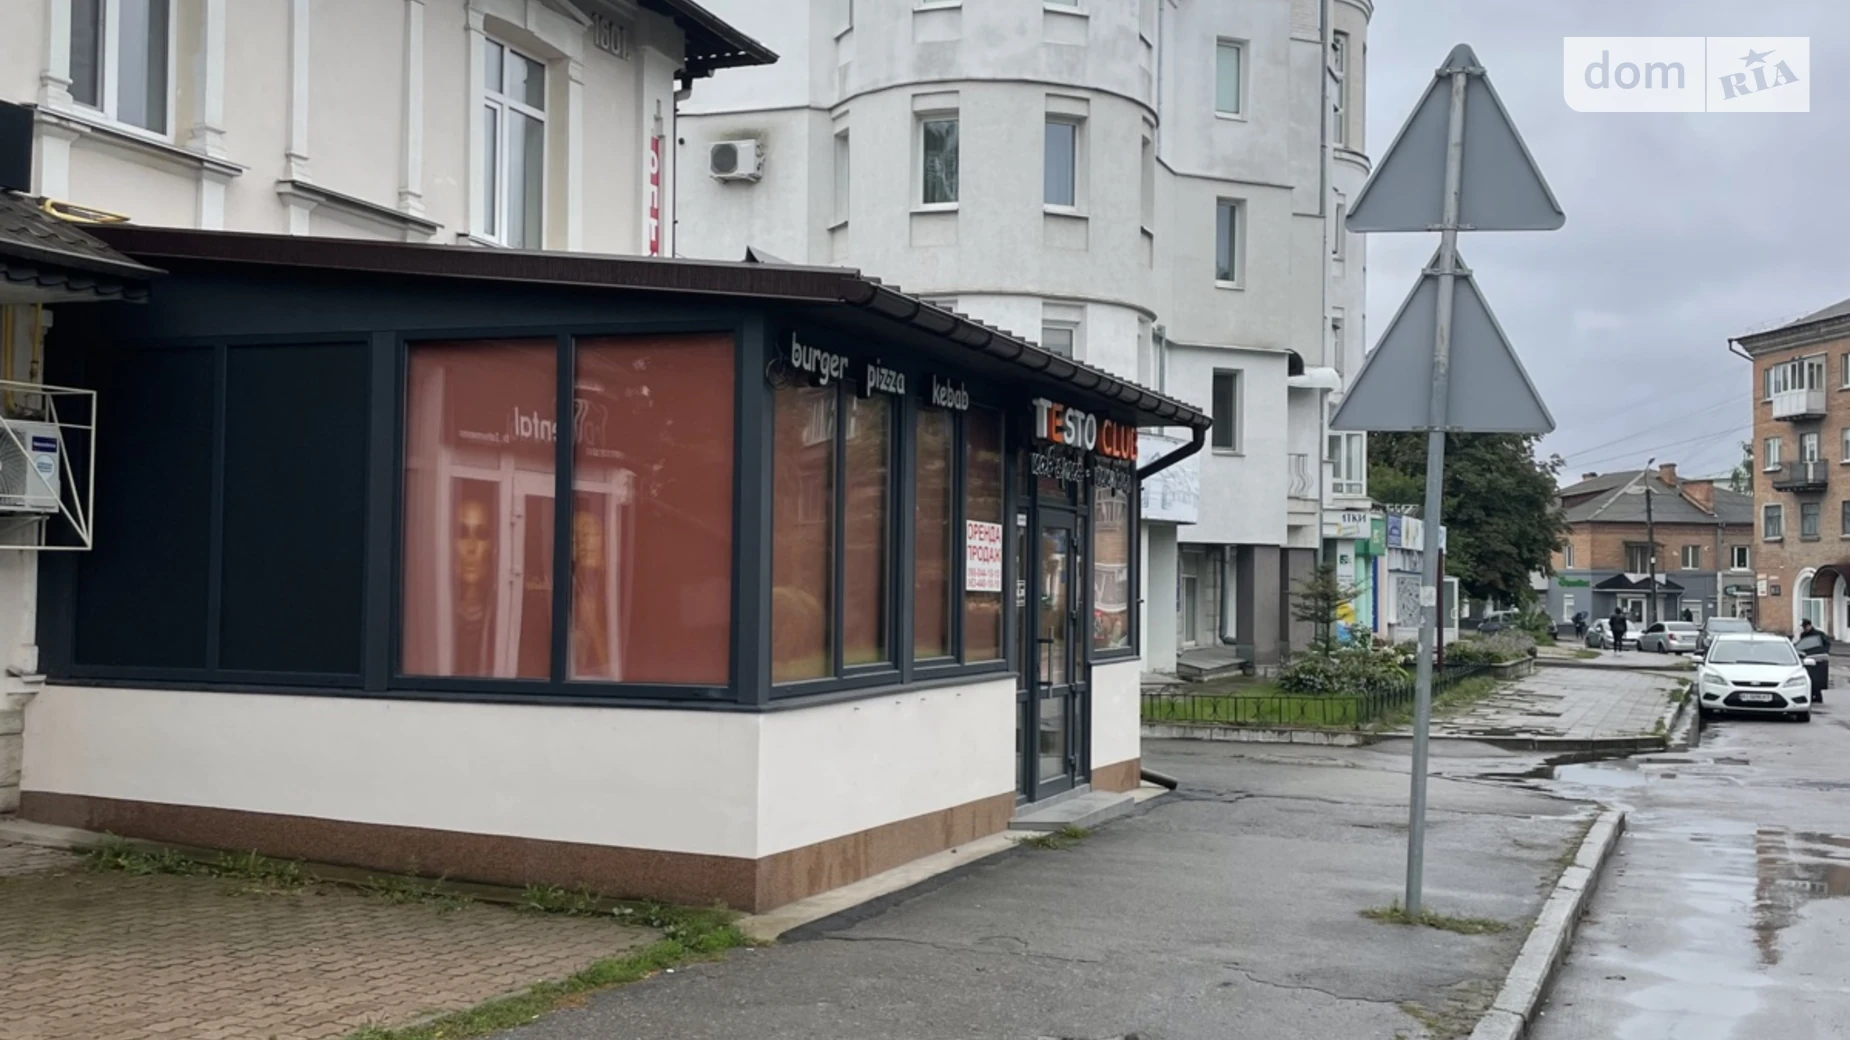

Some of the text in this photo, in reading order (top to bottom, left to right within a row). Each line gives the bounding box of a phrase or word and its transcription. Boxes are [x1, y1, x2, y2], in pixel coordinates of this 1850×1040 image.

[791, 331, 969, 411] burger pizza kebab
[1032, 397, 1138, 461] TESTO CLUB
[967, 522, 1001, 545] ОРЕНДА
[967, 545, 1001, 564] ПРОДАЖ
